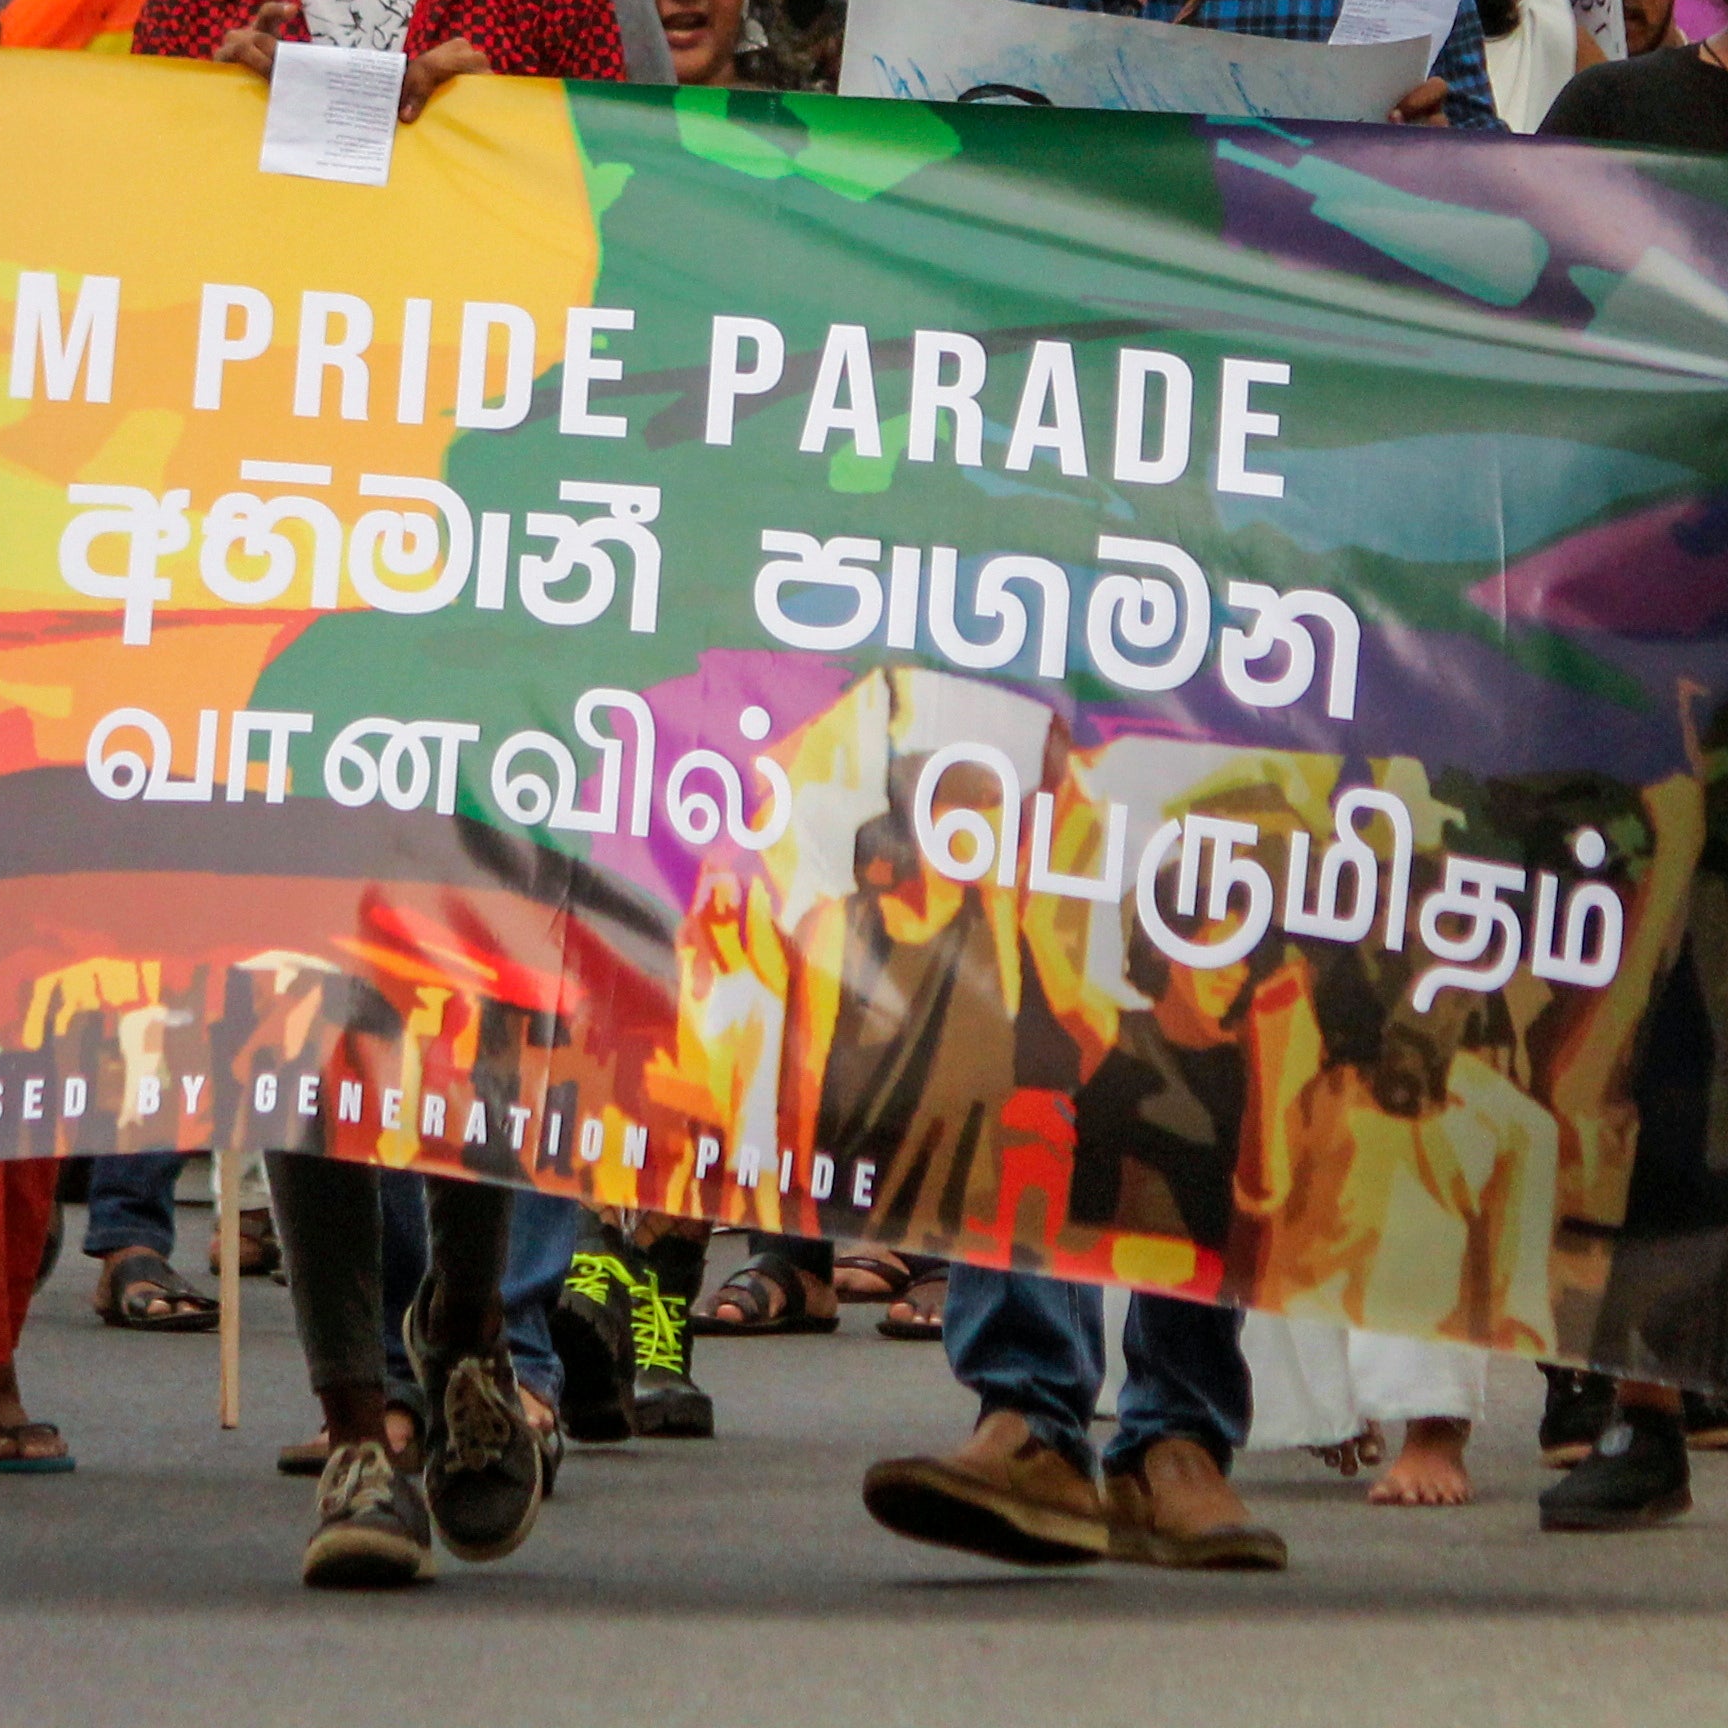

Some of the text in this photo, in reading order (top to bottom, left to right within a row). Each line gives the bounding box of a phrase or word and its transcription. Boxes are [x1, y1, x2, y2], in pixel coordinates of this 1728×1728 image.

[193, 282, 635, 439] PRIDE
[705, 315, 1292, 499] PARADE
[58, 458, 662, 646] අභිමානී
[753, 528, 1362, 721] පාගමන
[84, 687, 793, 851] வானவில்
[913, 741, 1625, 1013] பெருமிதம்
[137, 1074, 206, 1115] BY
[254, 1073, 649, 1170] GENERATION
[695, 1137, 877, 1209] PRIDE
